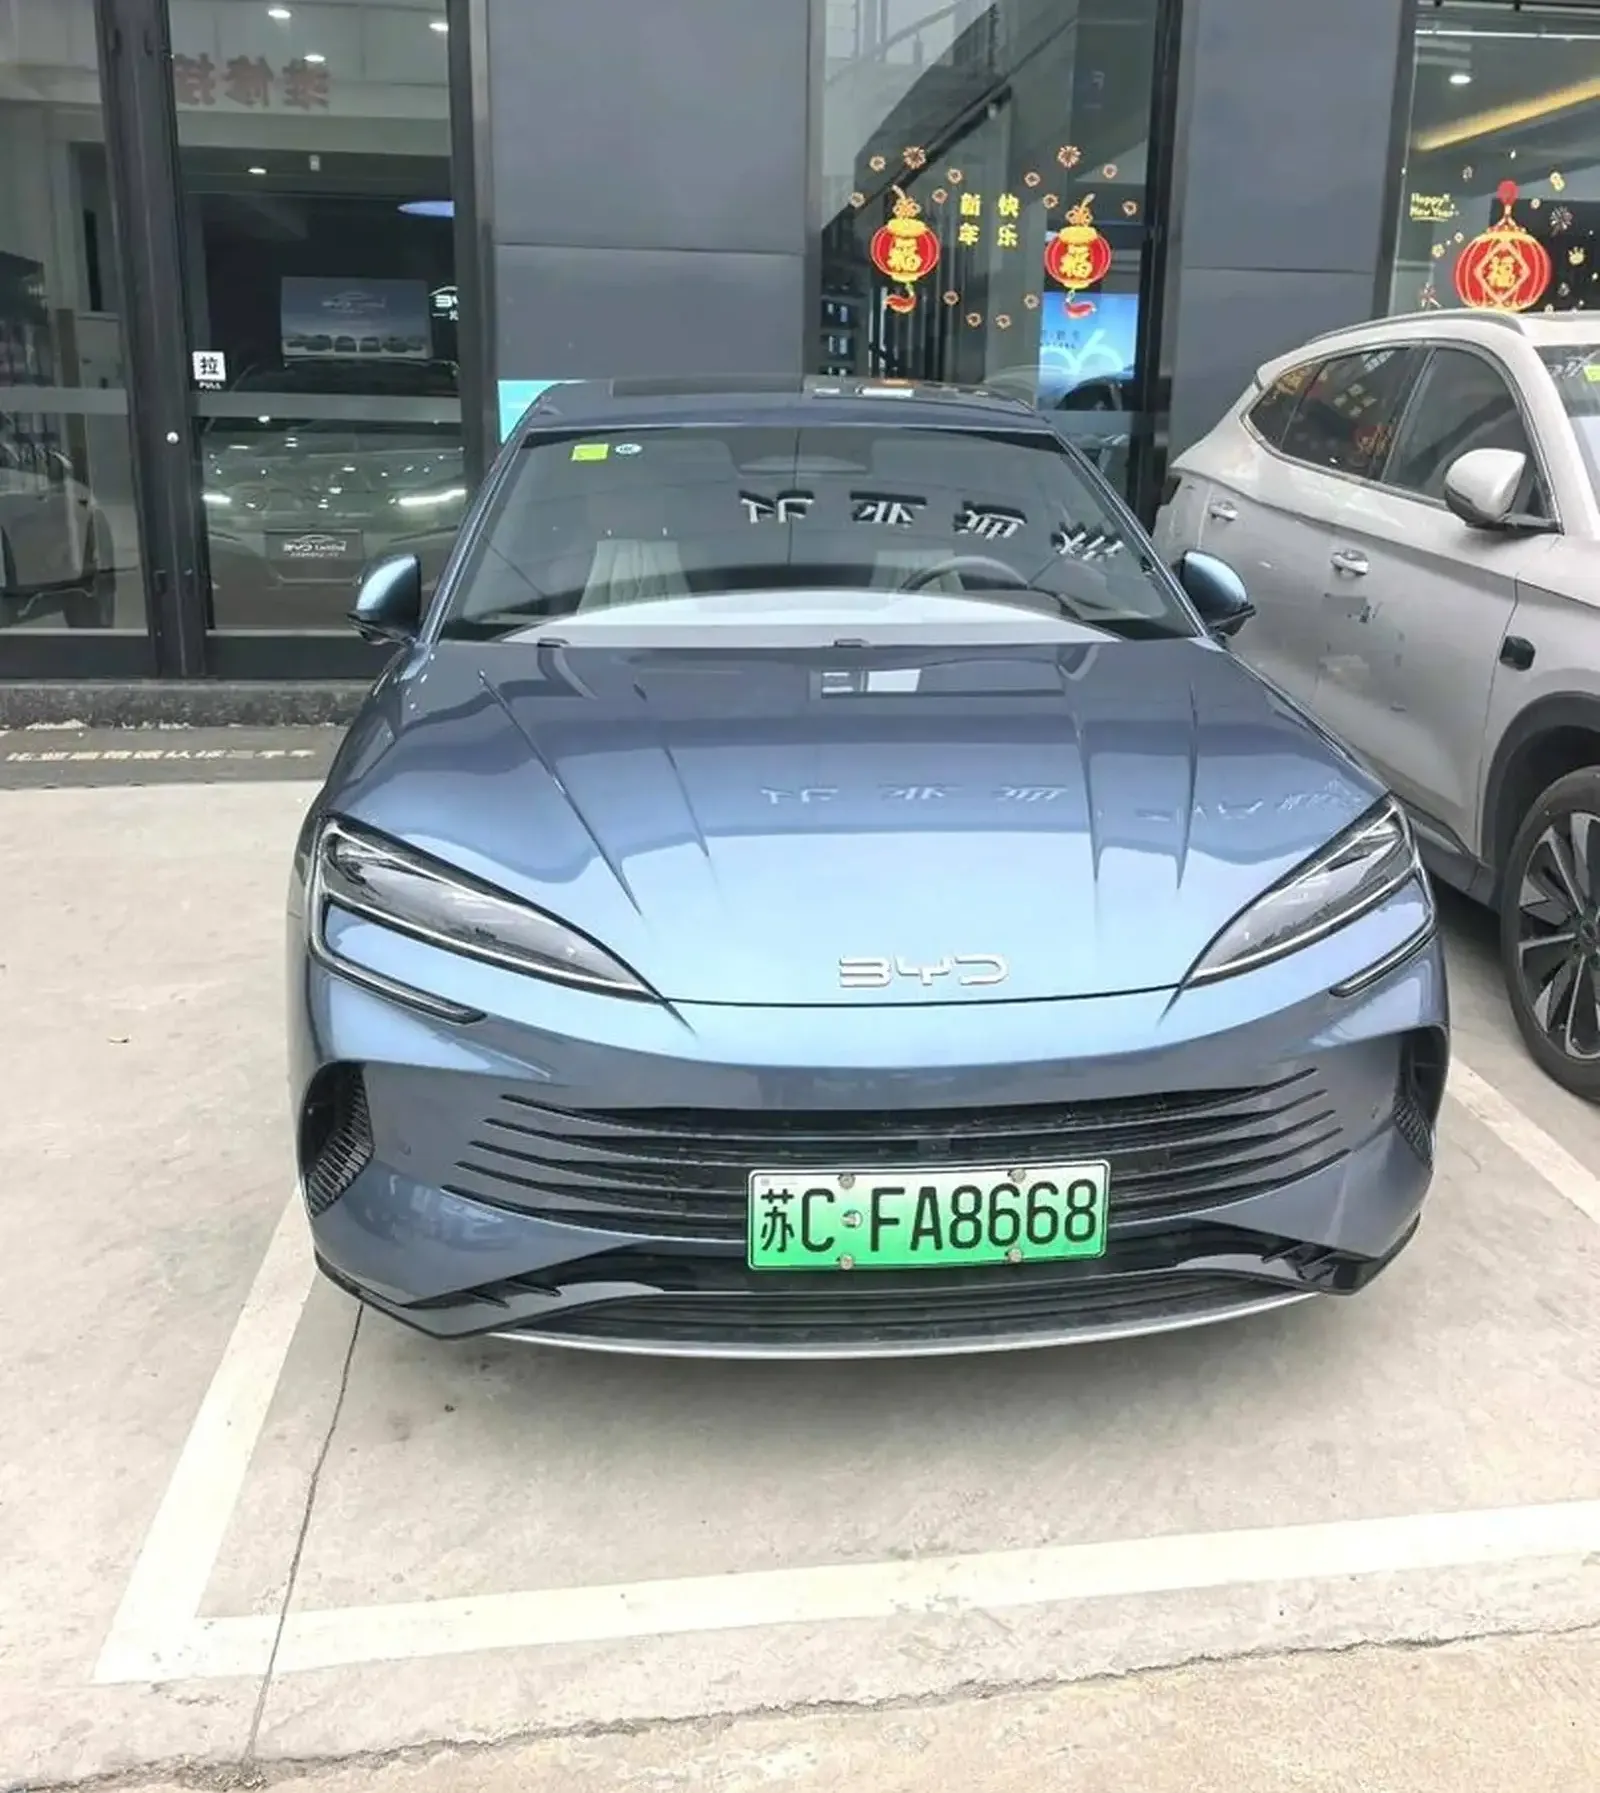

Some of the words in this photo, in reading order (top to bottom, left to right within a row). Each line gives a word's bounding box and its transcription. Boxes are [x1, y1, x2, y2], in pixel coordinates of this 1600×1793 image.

[997, 193, 1020, 247] 快乐
[887, 238, 923, 272] 福
[1059, 244, 1093, 279] 福
[1485, 256, 1517, 289] 福
[200, 356, 219, 376] 拉
[837, 952, 1010, 989] BYD
